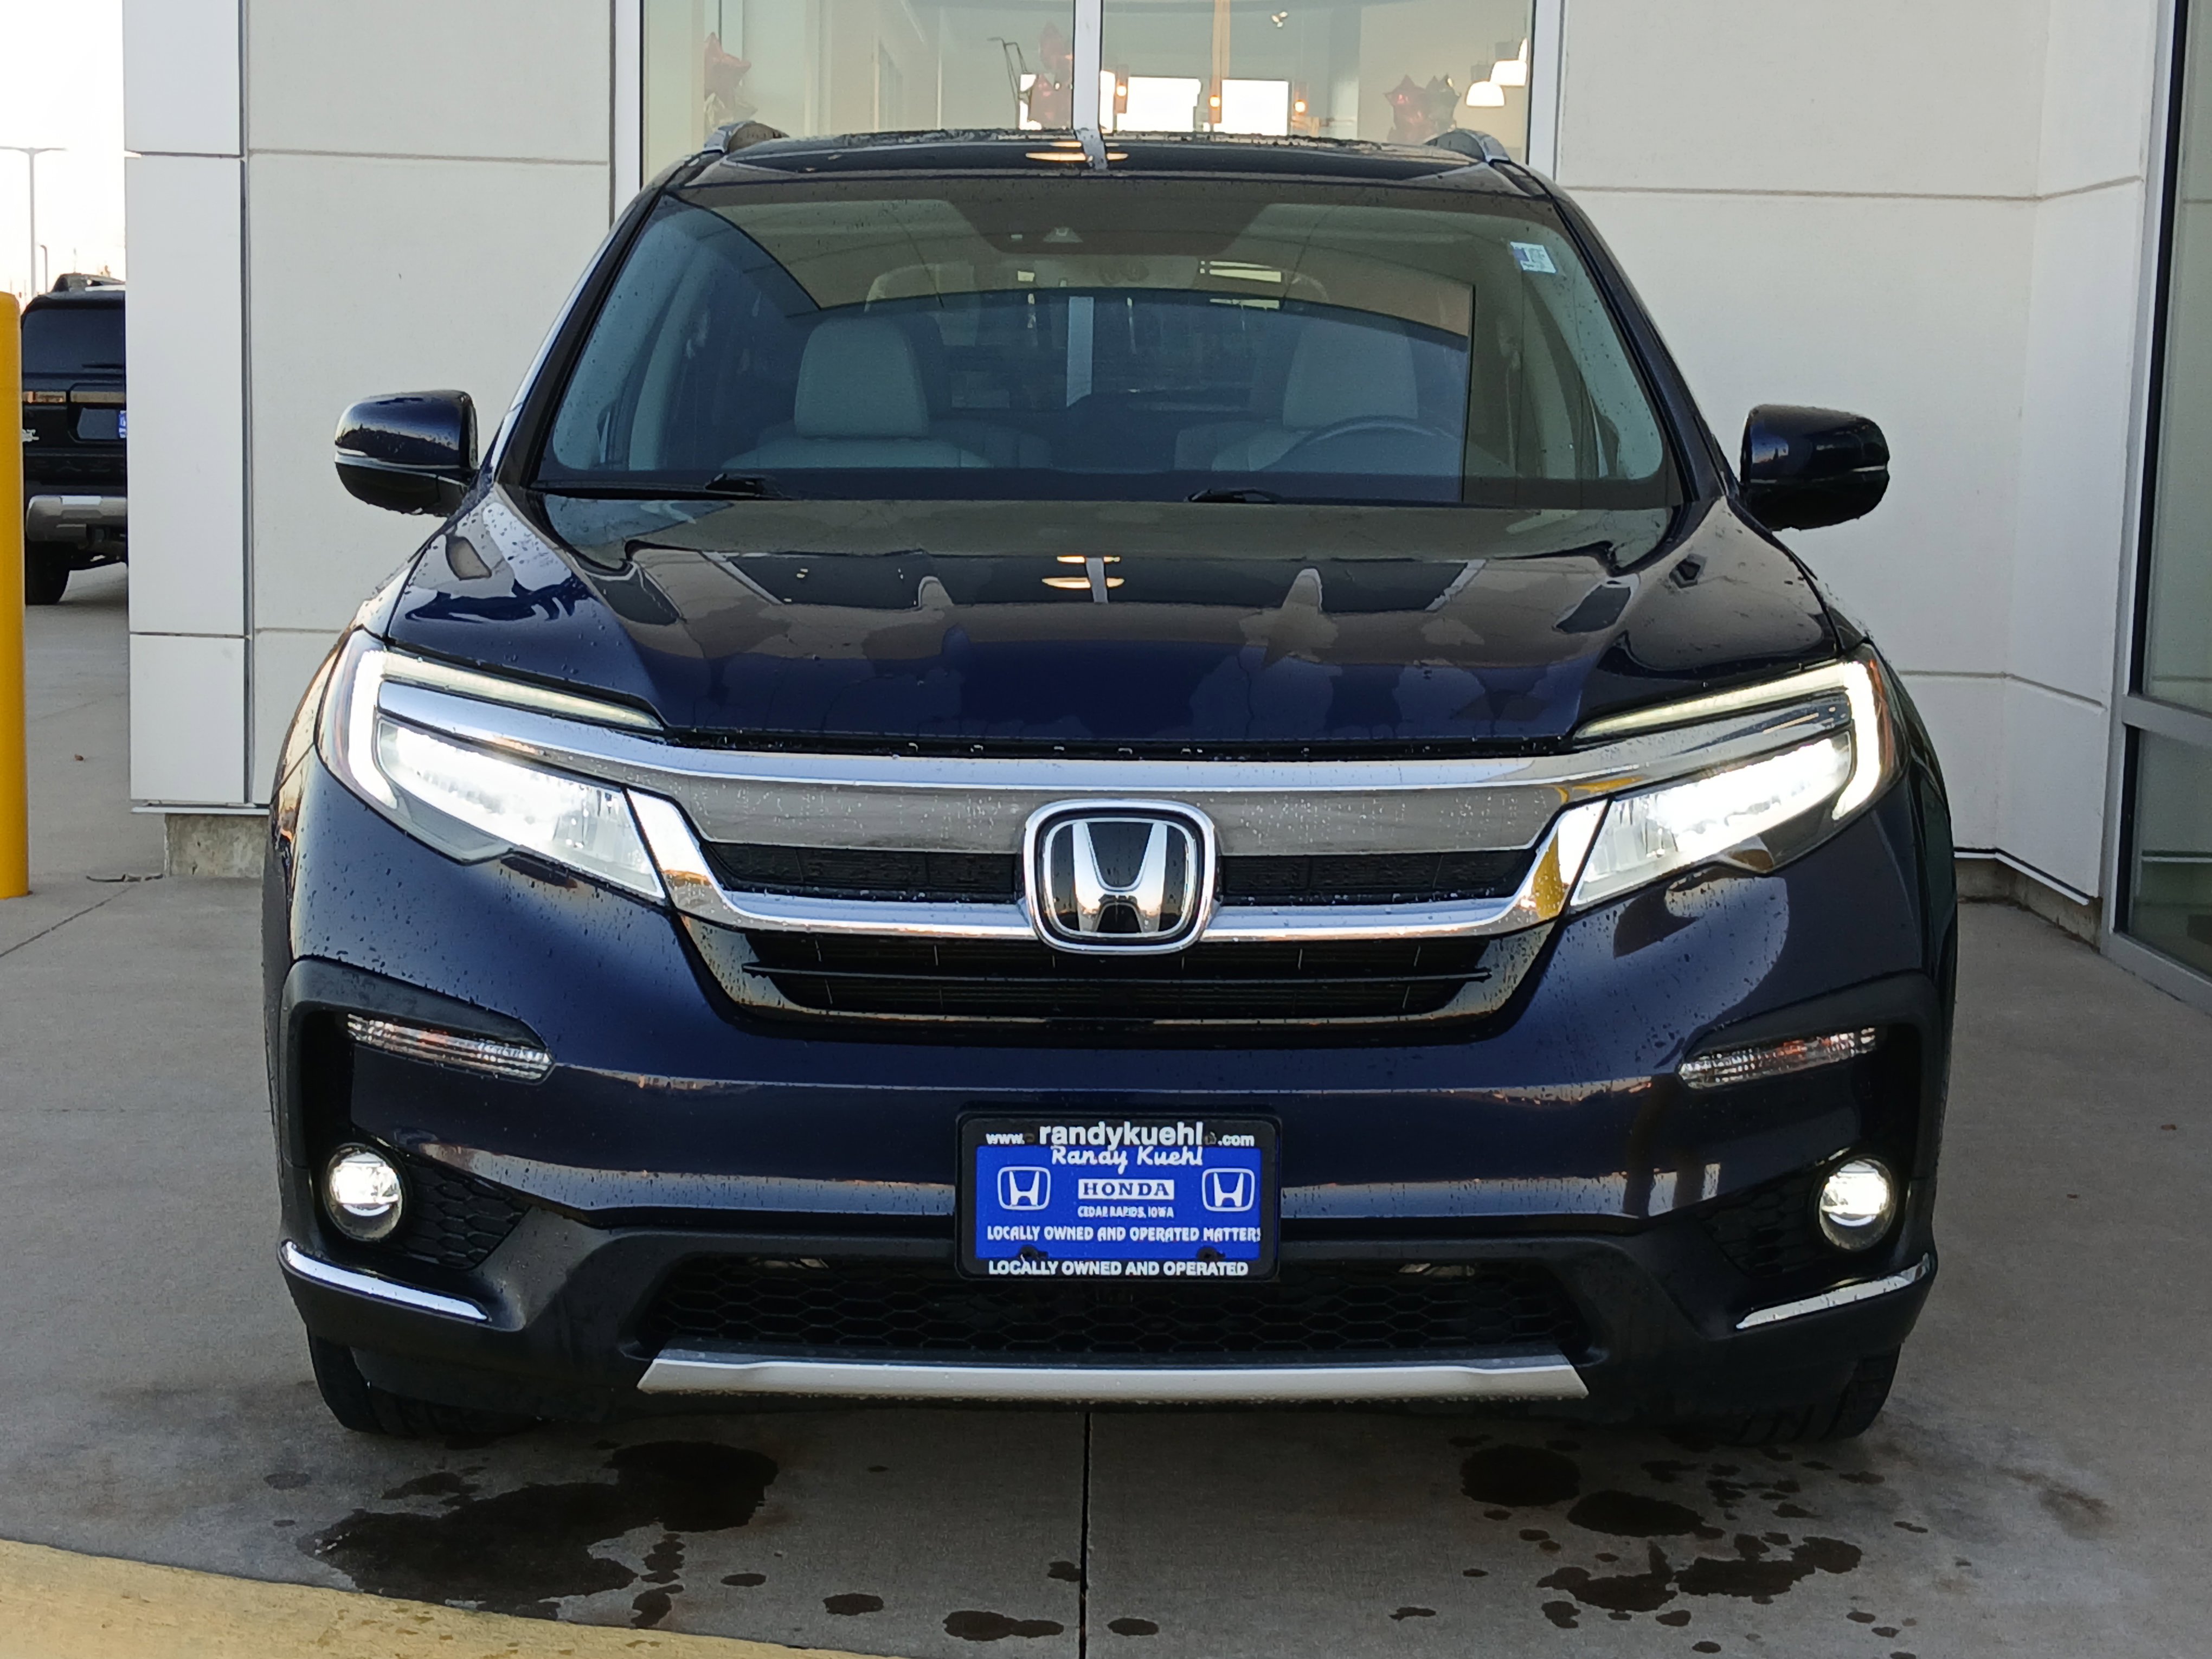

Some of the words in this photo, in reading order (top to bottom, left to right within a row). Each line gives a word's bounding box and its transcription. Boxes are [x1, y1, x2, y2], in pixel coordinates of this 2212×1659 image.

[986, 1133, 1025, 1145] www.
[1039, 1121, 1204, 1151] randykuehl
[1217, 1134, 1255, 1147] .com
[1050, 1145, 1129, 1175] Randy
[1136, 1145, 1204, 1166] Kuehl
[1083, 1182, 1170, 1197] HONDA
[1148, 1206, 1175, 1218] IOWA
[987, 1225, 1041, 1242] LOCALLY
[1044, 1226, 1094, 1241] OWNED
[1097, 1227, 1126, 1242] AND
[1129, 1227, 1200, 1243] OPERATED
[988, 1260, 1059, 1276] LOCALLY
[1061, 1261, 1122, 1276] OWNED
[1124, 1261, 1160, 1276] AND
[1163, 1261, 1249, 1276] OPERATED
